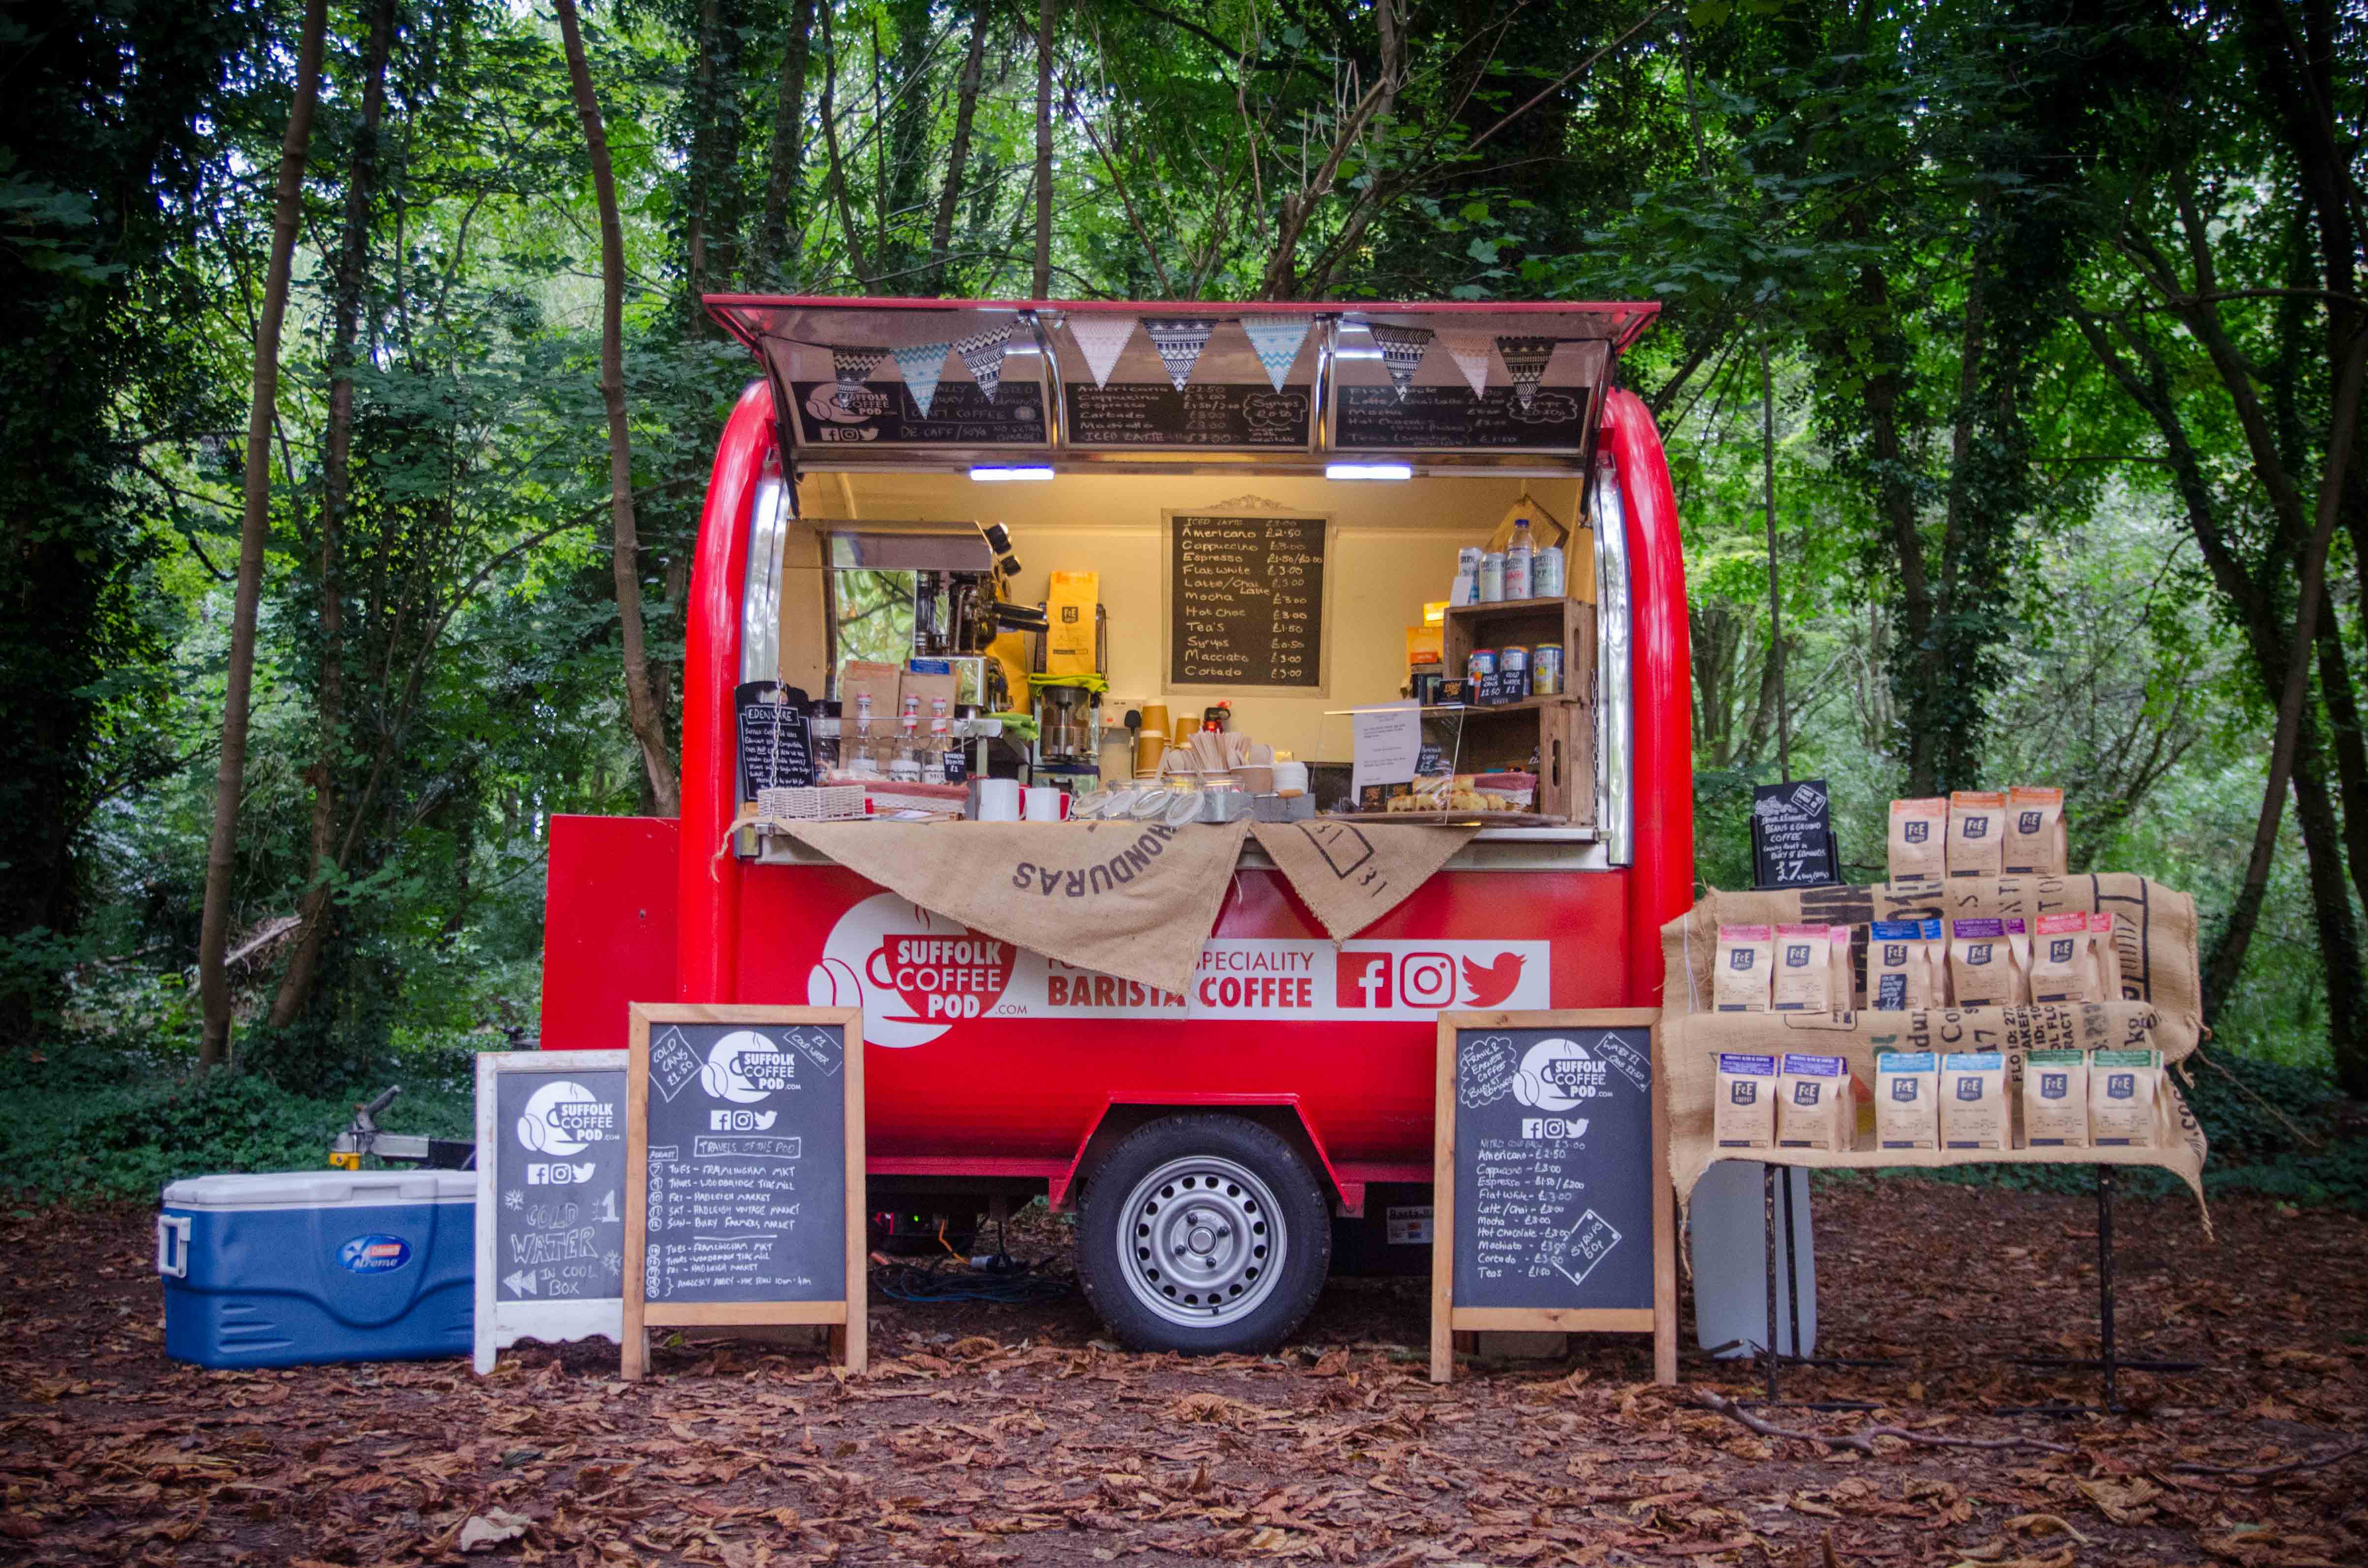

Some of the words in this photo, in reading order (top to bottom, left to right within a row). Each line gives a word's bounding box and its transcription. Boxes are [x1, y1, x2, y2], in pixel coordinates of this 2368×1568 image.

[1182, 528, 1256, 538] Americano
[1182, 541, 1258, 552] Cappuccino
[1183, 553, 1243, 563] Espresso
[1183, 564, 1213, 575] Flat
[1185, 606, 1213, 617] Hot
[1187, 636, 1229, 651] Syrups
[1184, 666, 1242, 676] Cortado
[1908, 824, 1925, 835] F&E
[1968, 820, 1985, 830] F&E
[2023, 813, 2039, 825] F&E
[1770, 832, 1803, 842] COFFEE
[1011, 822, 1181, 898] HONDURAS
[898, 940, 1002, 966] SUFFOLK
[1735, 952, 1751, 963] F&E
[1790, 948, 1807, 959] F&E
[1888, 946, 1904, 958] F&E
[1972, 946, 1989, 957] F&E
[2054, 942, 2070, 954] F&E
[897, 967, 1001, 992] COFFEE
[1048, 975, 1186, 1008] BARISTA
[1199, 977, 1312, 1008] COFFEE
[928, 994, 981, 1018] POD
[995, 1004, 1028, 1015] .COM
[654, 1039, 676, 1063] COLD
[662, 1048, 687, 1072] CANS
[745, 1053, 795, 1065] SUFFOLK
[744, 1066, 795, 1077] COFFEE
[1478, 1060, 1506, 1082] COFFEE
[1555, 1061, 1606, 1073] SUFFOLK
[759, 1078, 784, 1090] POD
[1555, 1074, 1606, 1085] COFFEE
[1570, 1085, 1596, 1098] POD
[1736, 1083, 1753, 1095] F&E
[1799, 1084, 1816, 1097] F&E
[1896, 1080, 1914, 1092] F&E
[1961, 1079, 1978, 1092] F&E
[2045, 1077, 2063, 1090] F&E
[2111, 1077, 2130, 1090] F&E
[561, 1104, 613, 1116] SUFFOLK
[561, 1117, 613, 1129] COFFEE
[577, 1129, 603, 1141] POD
[699, 1141, 736, 1154] TRAVELS
[776, 1142, 795, 1153] POD
[1478, 1149, 1527, 1161] Americano
[669, 1164, 690, 1174] TUES
[773, 1167, 795, 1177] MKT
[701, 1179, 754, 1188] WOODBRIDGE
[1477, 1176, 1521, 1189] Espresso
[669, 1193, 683, 1202] FRI
[694, 1192, 735, 1201] HADLEIGH
[738, 1193, 771, 1202] MARKET
[1479, 1189, 1500, 1199] Flat
[527, 1202, 579, 1230] COLD
[669, 1205, 684, 1215] SAT
[1478, 1216, 1505, 1226] Mocha
[1478, 1227, 1494, 1237] Hot
[511, 1227, 598, 1264] WATER
[754, 1243, 773, 1251] MKT
[1478, 1253, 1516, 1264] Cortado
[540, 1269, 556, 1280] IN
[563, 1265, 598, 1279] COOL
[1478, 1267, 1502, 1279] Teas
[549, 1281, 580, 1295] BOX
